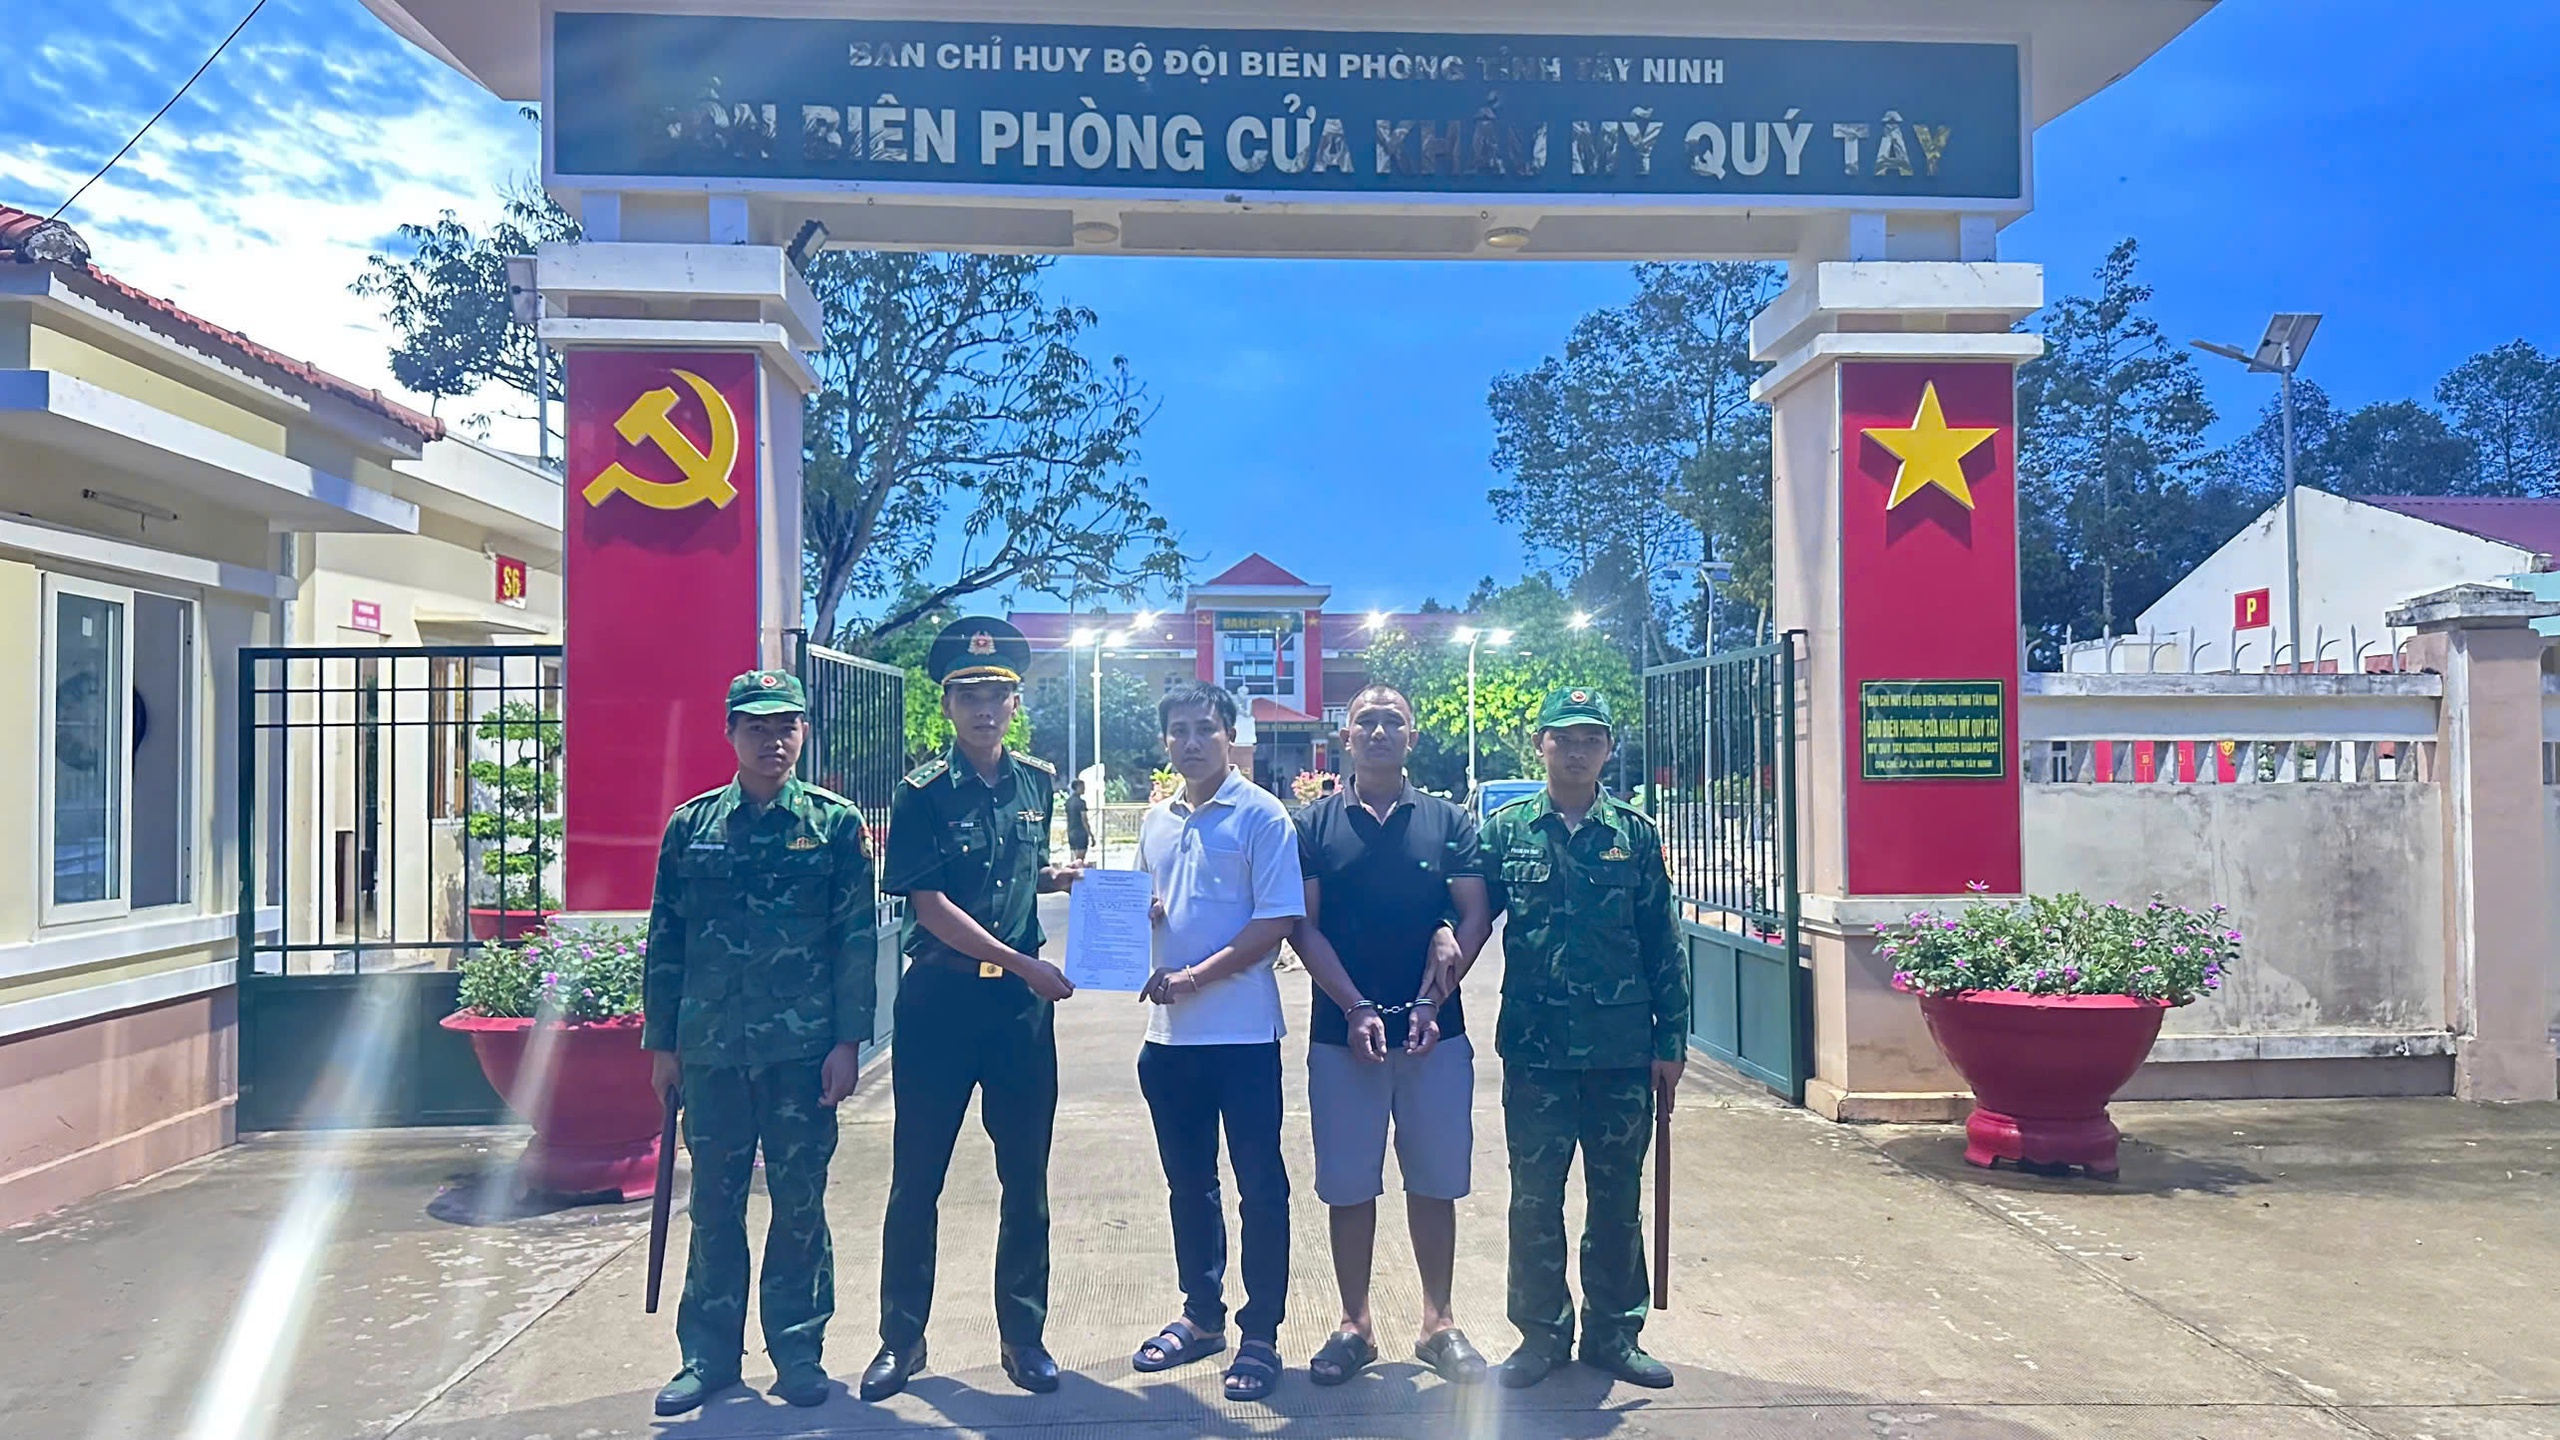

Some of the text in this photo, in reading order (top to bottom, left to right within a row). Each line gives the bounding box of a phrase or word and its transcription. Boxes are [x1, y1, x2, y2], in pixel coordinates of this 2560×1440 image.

[849, 43, 925, 68] BAN
[937, 35, 1002, 70] CHỈ
[1014, 46, 1092, 73] HUY
[1103, 42, 1152, 82] BỘ
[1164, 44, 1228, 84] ĐỘI
[1240, 46, 1326, 78] BIÊN
[1339, 48, 1465, 82] PHÒNG
[1643, 58, 1724, 84] NINH
[802, 93, 956, 163] BIÊN
[980, 96, 1205, 173] PHÒNG
[1226, 93, 1355, 173] CỬA
[1376, 90, 1547, 175] KHẨU
[1571, 106, 1664, 175] MỸ
[1685, 108, 1813, 180] QUÝ
[1832, 110, 1950, 176] TÂY
[503, 565, 521, 598] S6
[2246, 597, 2257, 623] P
